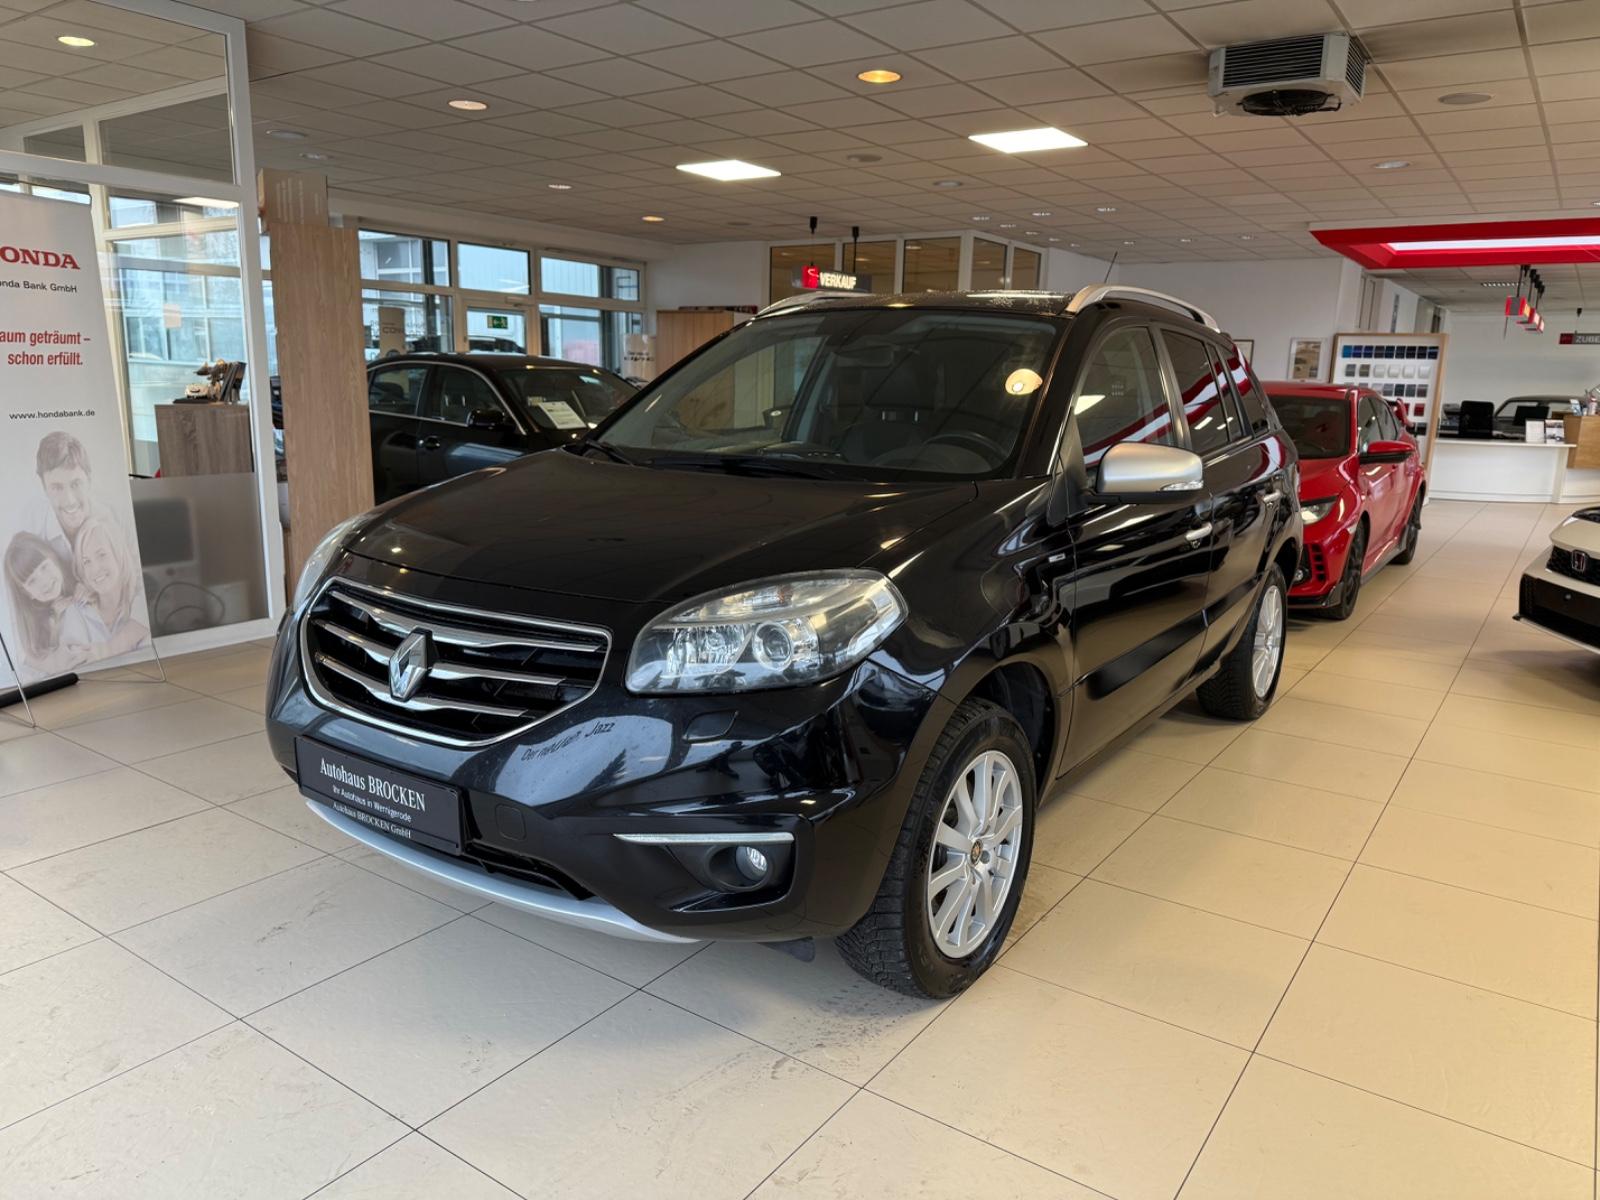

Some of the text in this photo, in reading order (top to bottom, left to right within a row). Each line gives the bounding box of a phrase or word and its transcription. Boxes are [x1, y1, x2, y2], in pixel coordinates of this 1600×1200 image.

[0, 280, 78, 293] nda Bank GmbH
[819, 272, 857, 289] VERKAUF
[30, 330, 81, 347] geträumt
[7, 351, 83, 366] schon erfüllt.
[9, 410, 95, 420] www.hondabank.de
[584, 721, 615, 738] Jazz
[319, 757, 426, 812] Autohaus BROCKEN
[341, 788, 366, 806] Autohaus
[366, 798, 373, 809] in
[373, 800, 412, 823] Wernigerode
[332, 801, 411, 839] Autohaus BROCKEN GmbH
